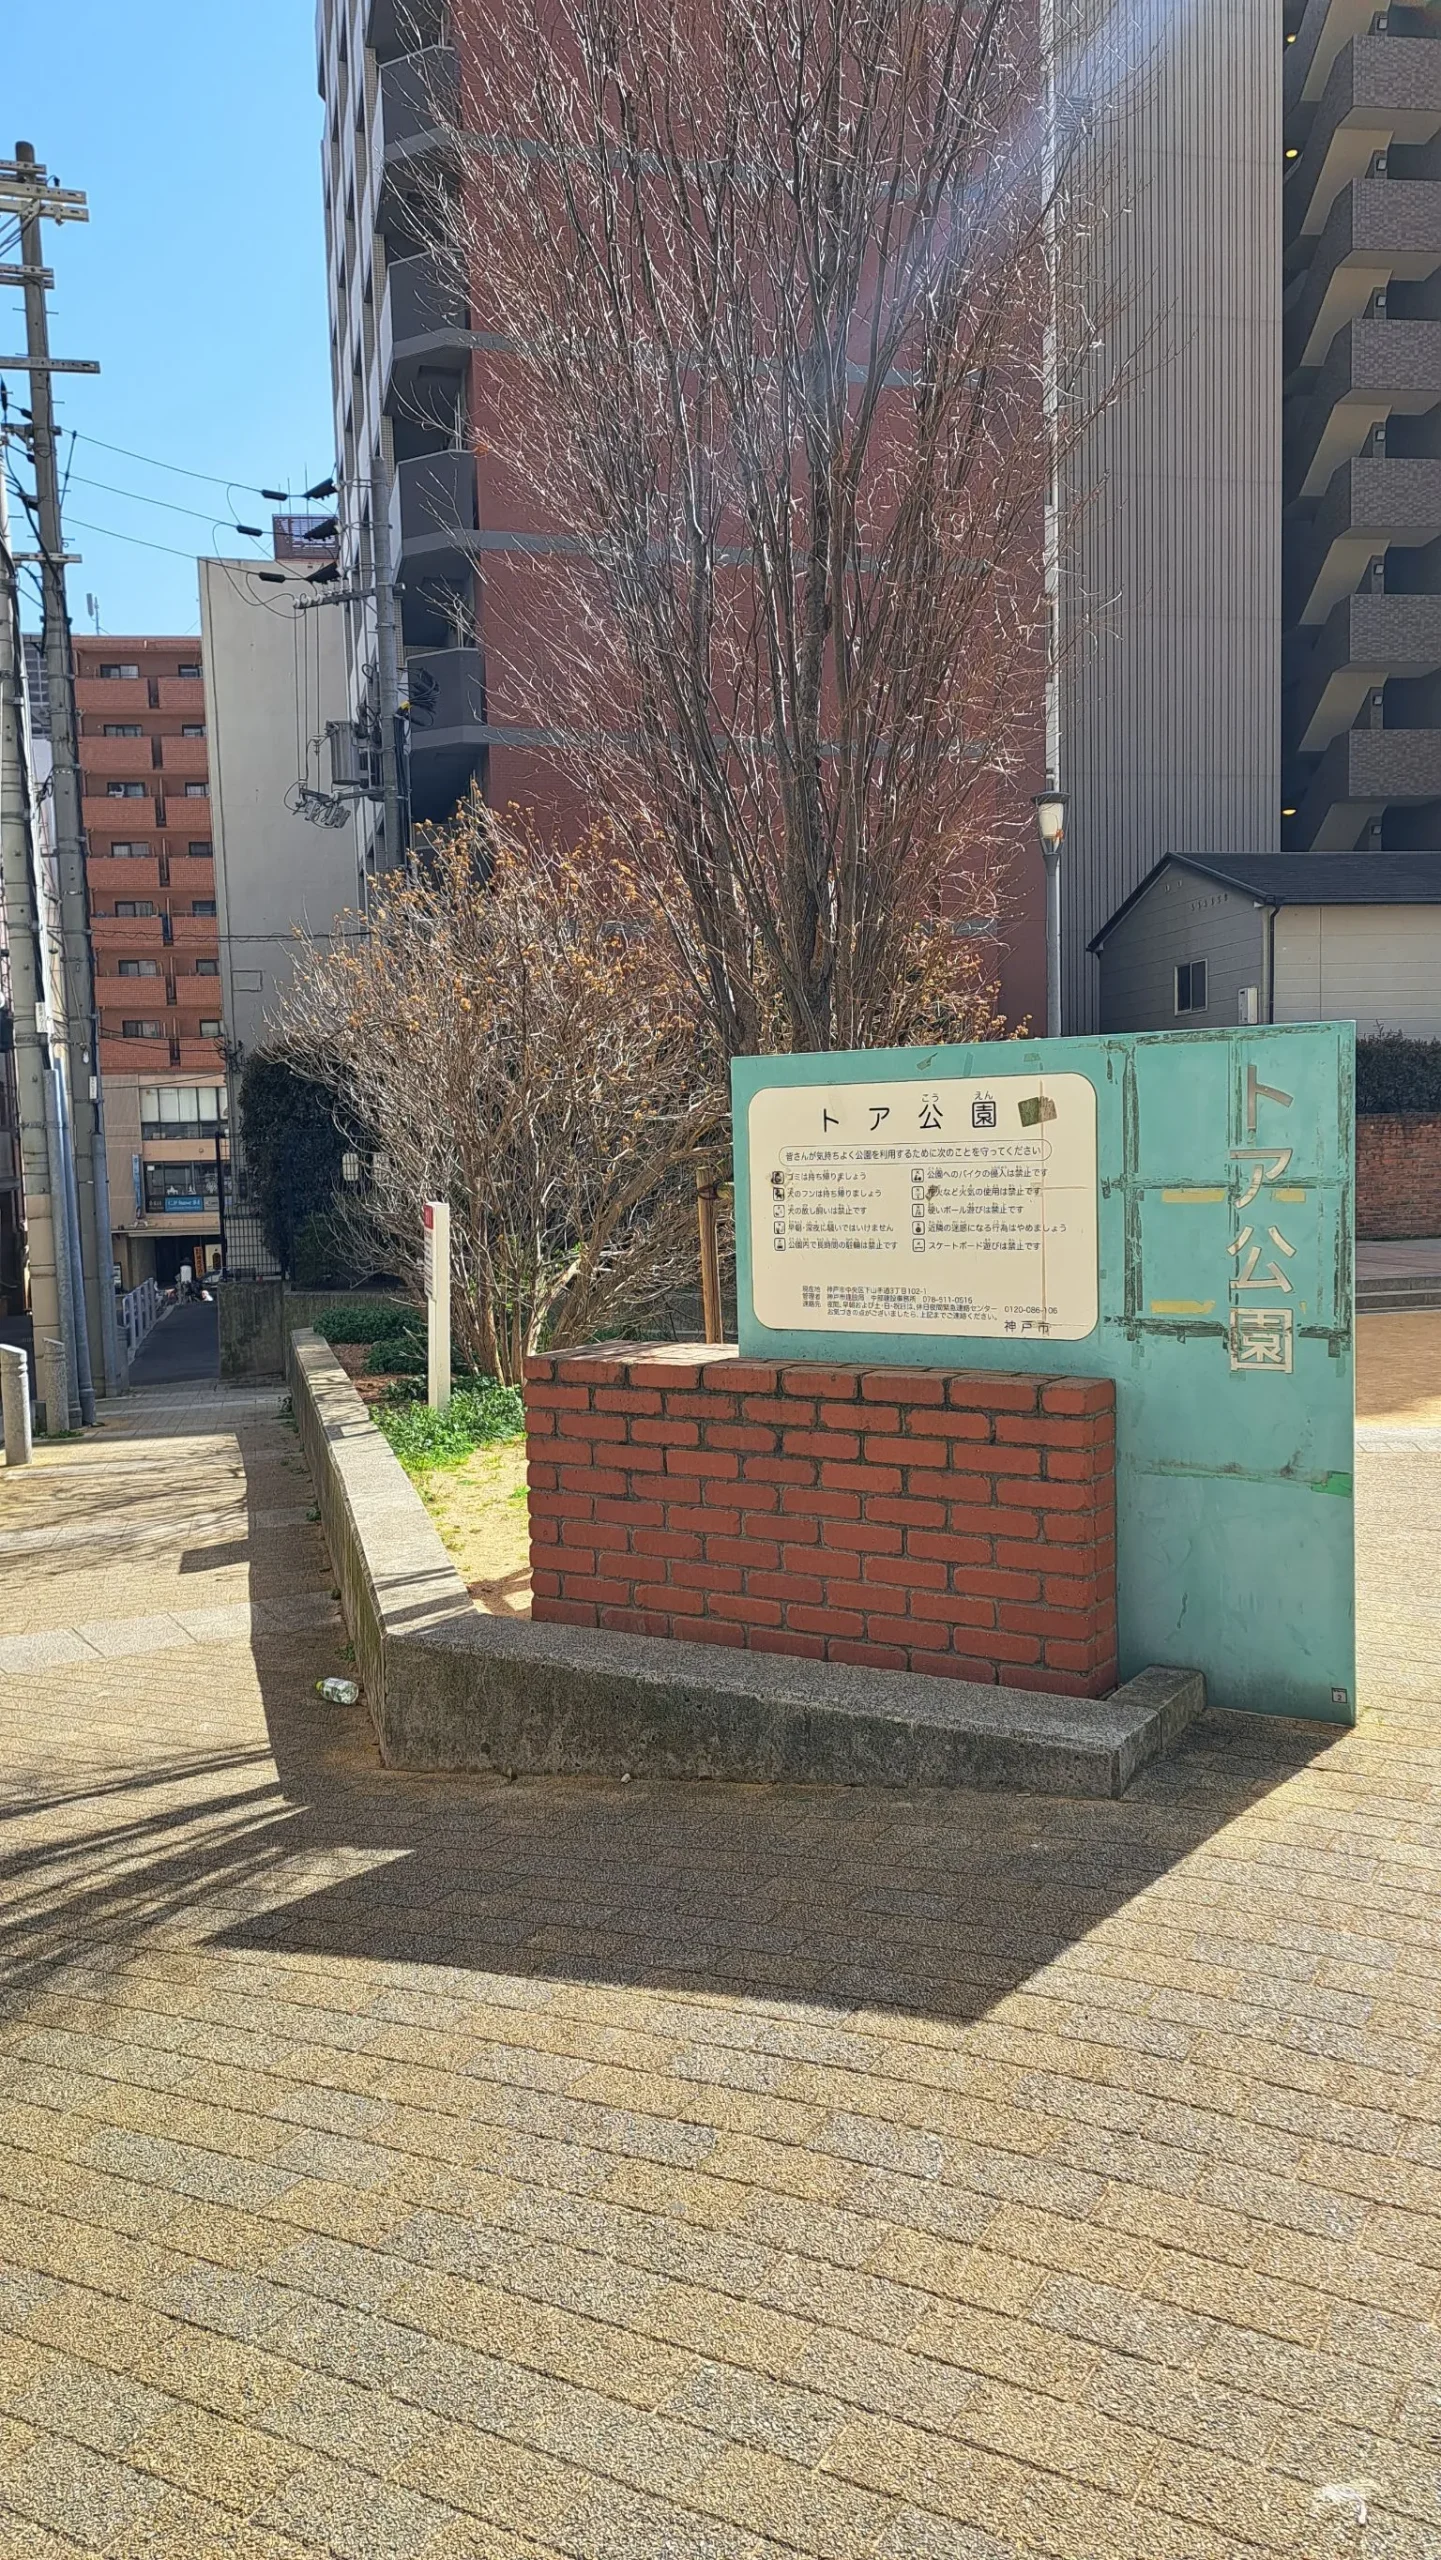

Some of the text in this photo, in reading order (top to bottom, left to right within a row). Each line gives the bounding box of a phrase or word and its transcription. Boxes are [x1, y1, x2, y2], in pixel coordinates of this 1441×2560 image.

[921, 1093, 939, 1102] こう
[974, 1090, 993, 1100] えん
[824, 1101, 997, 1133] トア公園
[786, 1146, 1042, 1161] 皆さんが気持ちよく公園を利用するために次のことを守ってください
[1227, 1065, 1297, 1374] トア公園
[1004, 1320, 1050, 1334] 神戸市
